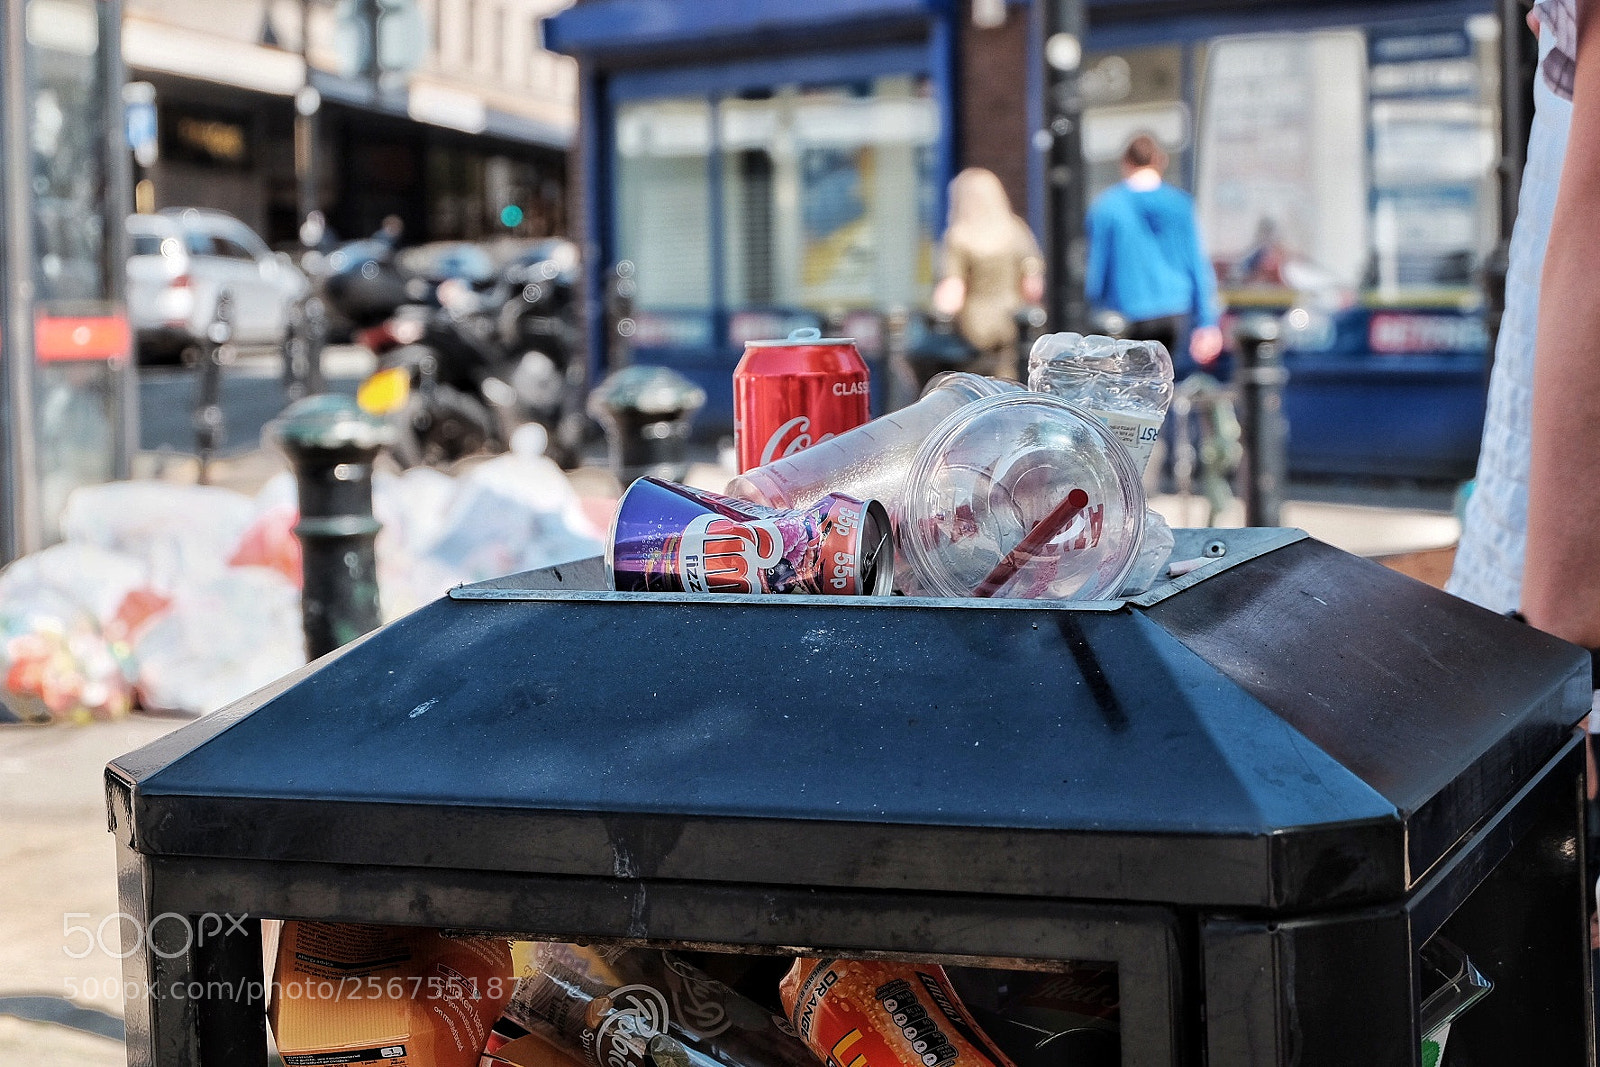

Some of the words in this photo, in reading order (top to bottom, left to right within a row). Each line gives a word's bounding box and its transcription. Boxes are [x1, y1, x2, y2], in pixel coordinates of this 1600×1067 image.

[833, 506, 860, 536] 55p
[829, 551, 856, 589] 55p
[800, 970, 839, 1043] ORANGE
